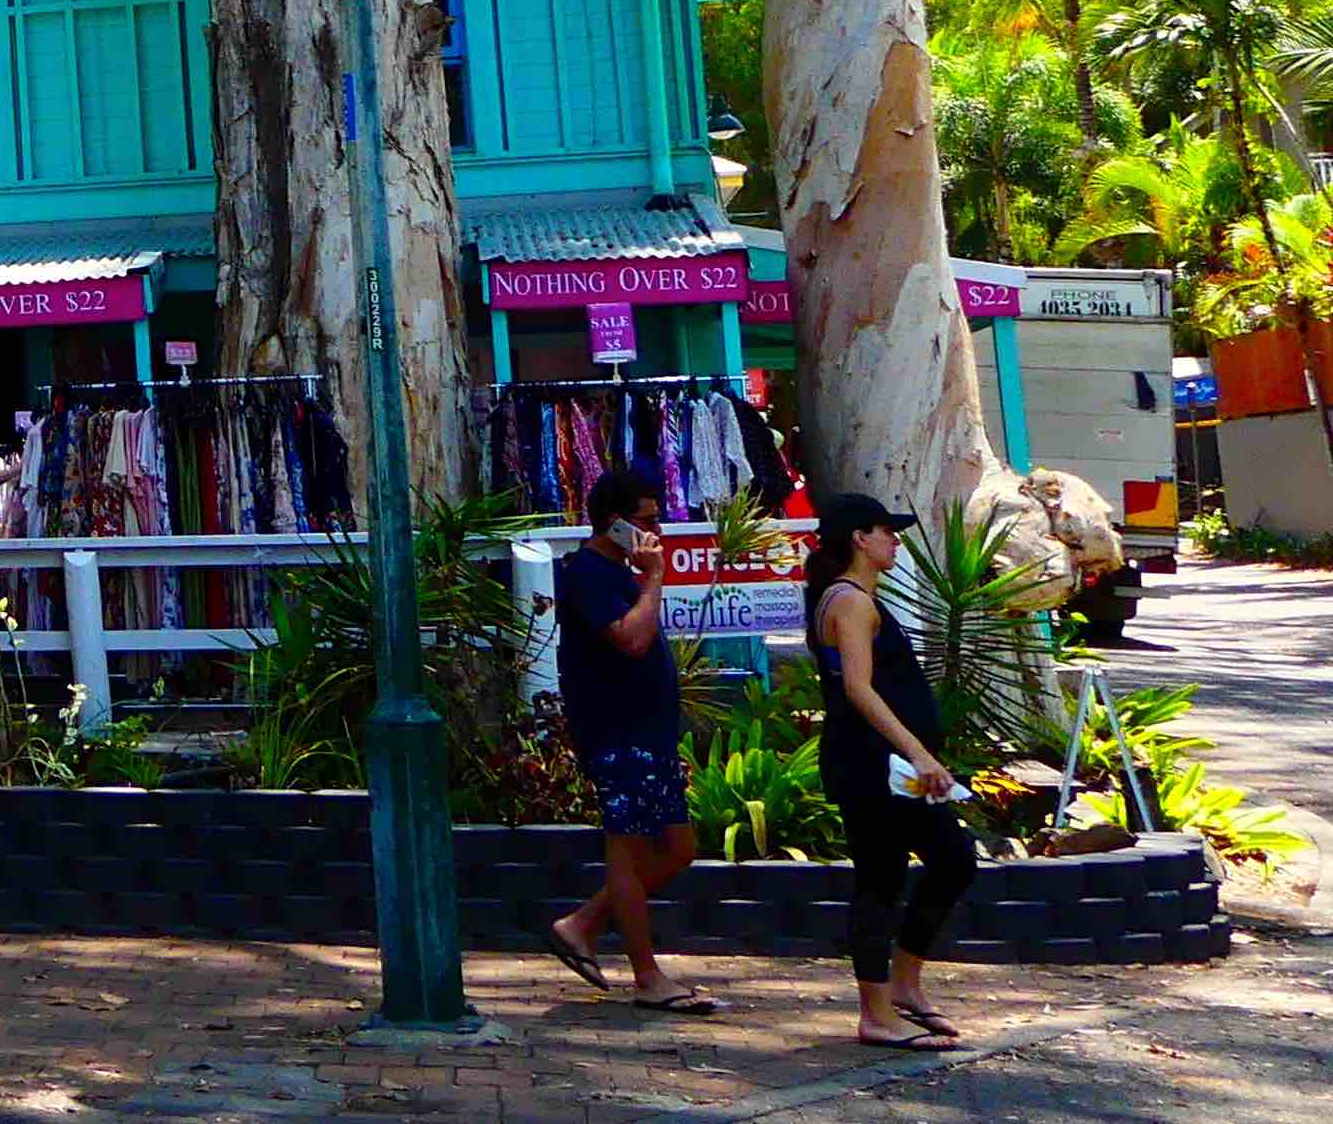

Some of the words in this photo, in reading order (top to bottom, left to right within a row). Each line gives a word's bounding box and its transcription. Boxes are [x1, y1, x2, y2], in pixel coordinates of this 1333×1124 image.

[493, 272, 606, 296] NOTHING
[618, 266, 690, 291] OVER
[700, 267, 738, 290] $22
[65, 290, 106, 313] $22
[968, 286, 1011, 307] $22
[1050, 289, 1118, 300] PHONE
[590, 316, 630, 329] SALE
